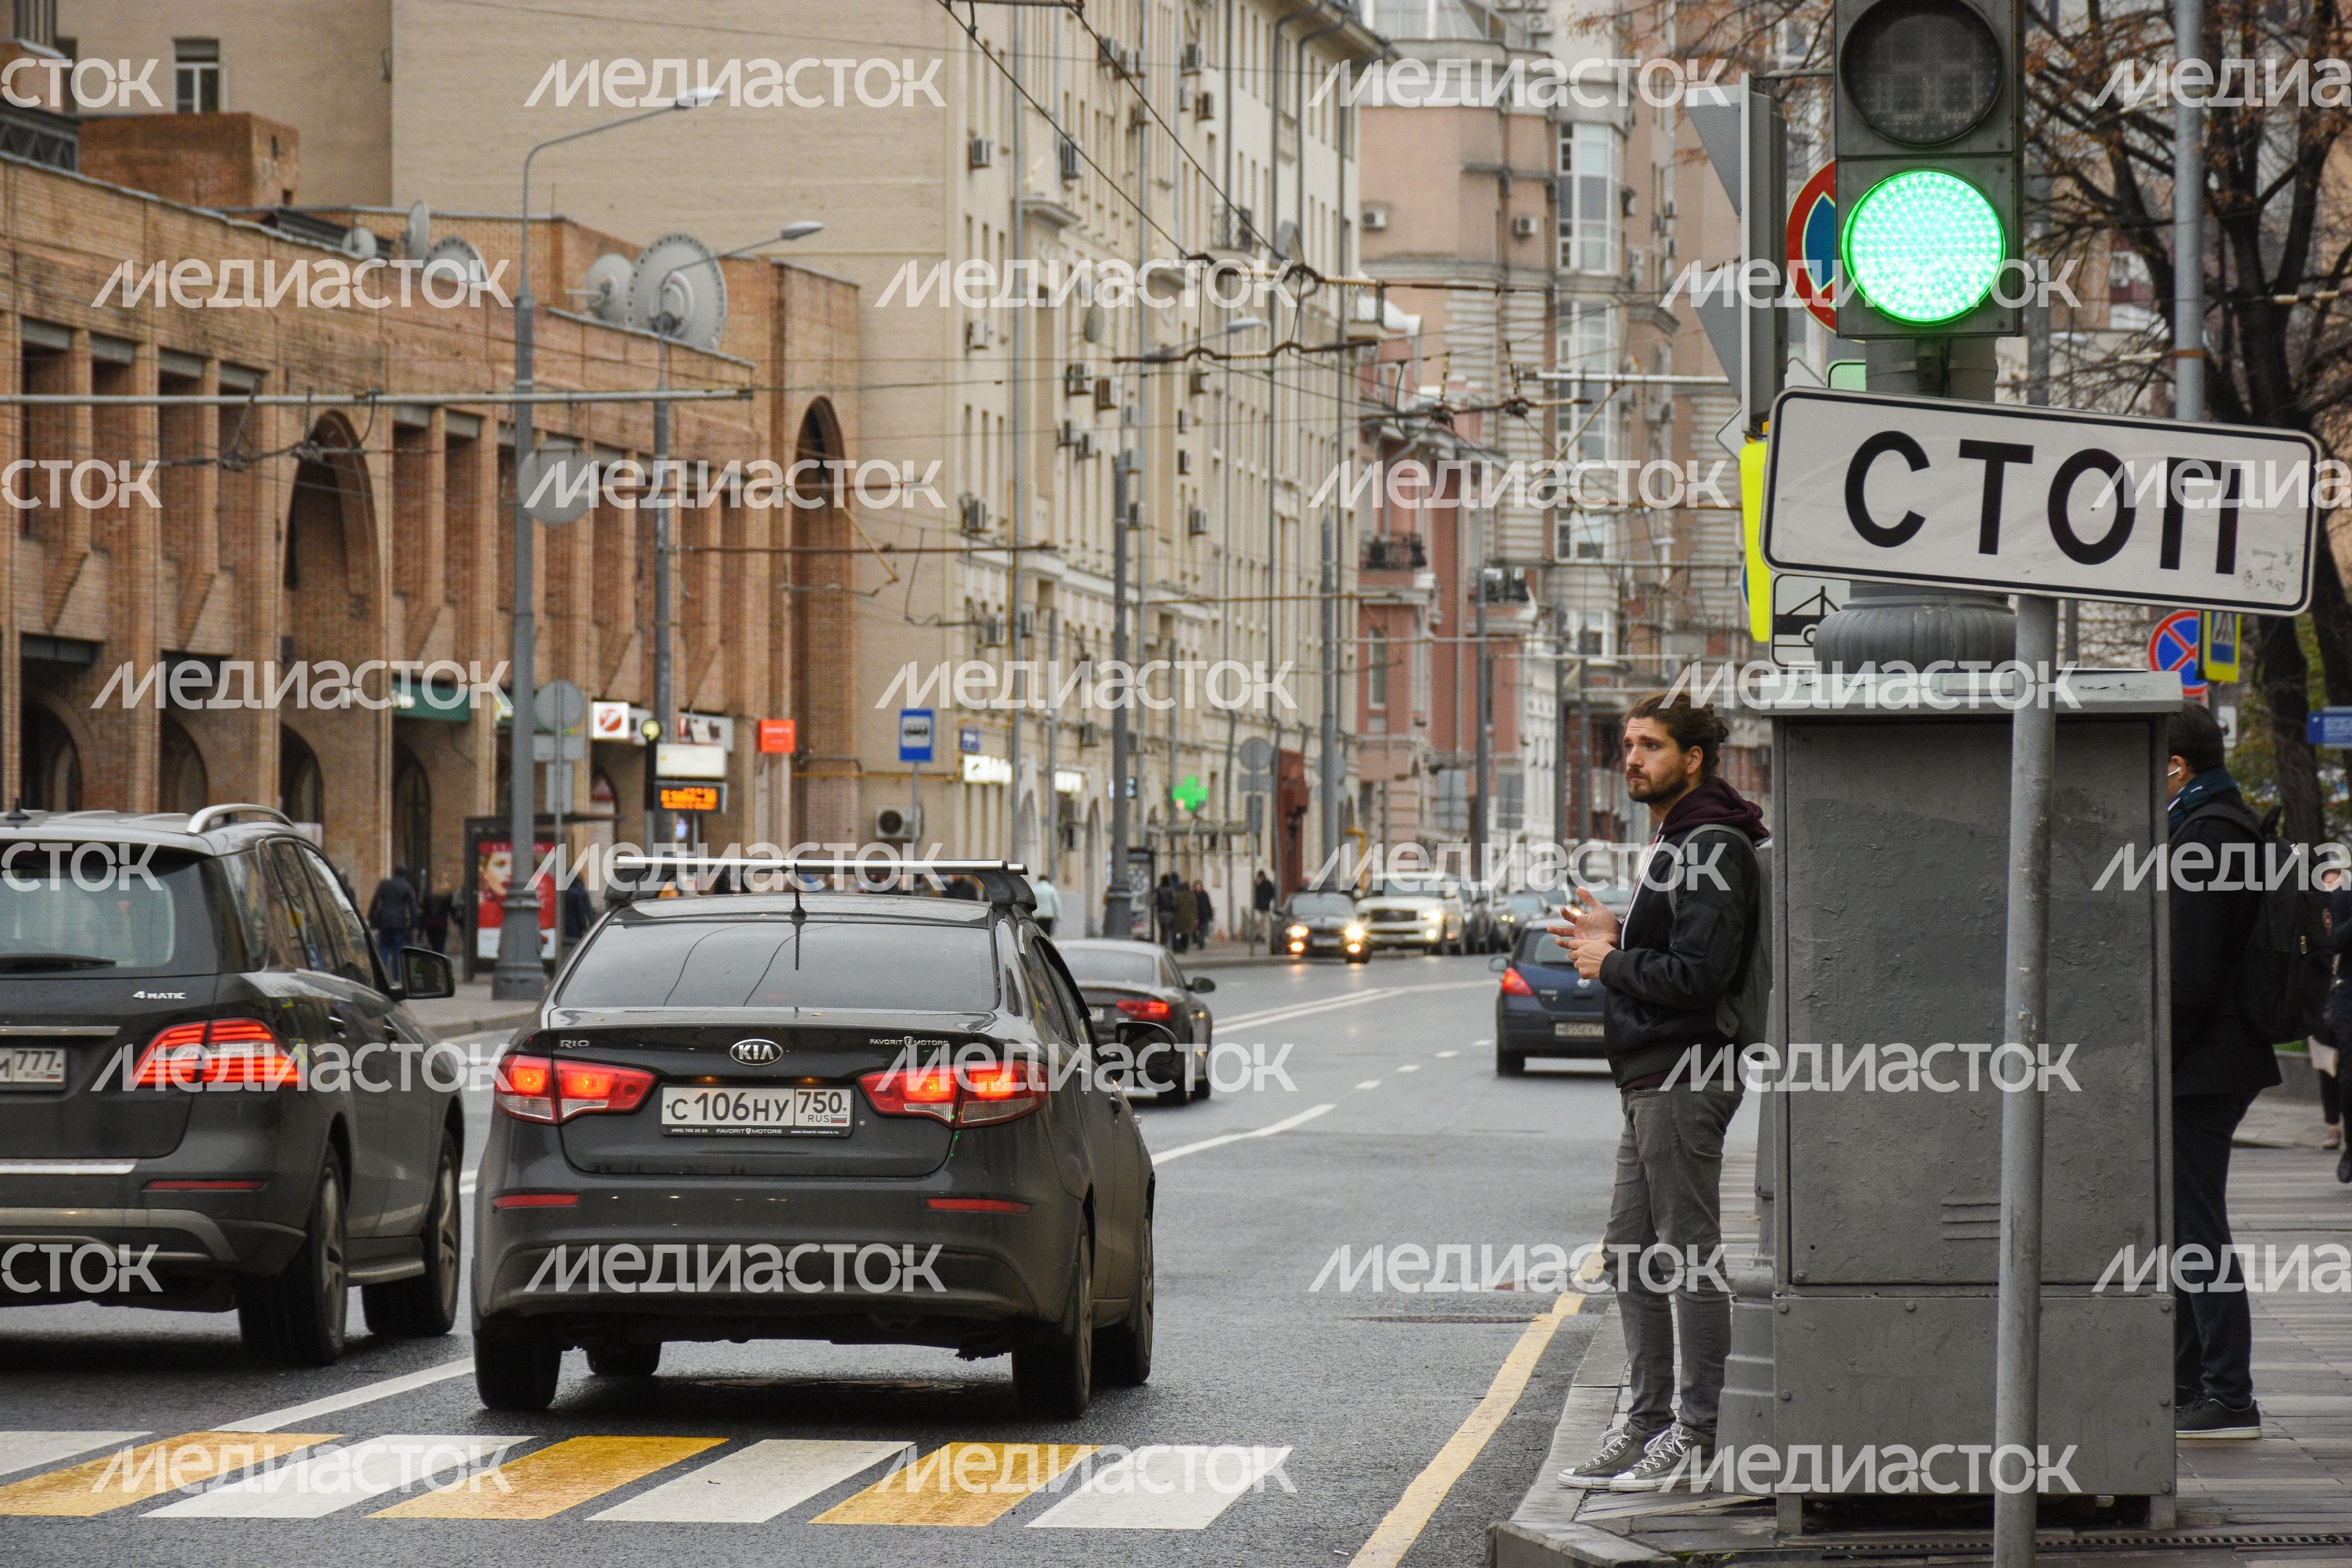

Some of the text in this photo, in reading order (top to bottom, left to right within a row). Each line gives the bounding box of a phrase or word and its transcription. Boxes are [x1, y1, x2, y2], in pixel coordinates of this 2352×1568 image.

[1845, 430, 2242, 575] СТОП
[560, 1040, 590, 1049] RIO
[738, 1045, 775, 1060] KIA
[14, 1050, 57, 1071] 777
[797, 1091, 842, 1114] 750
[807, 1114, 830, 1123] RUS
